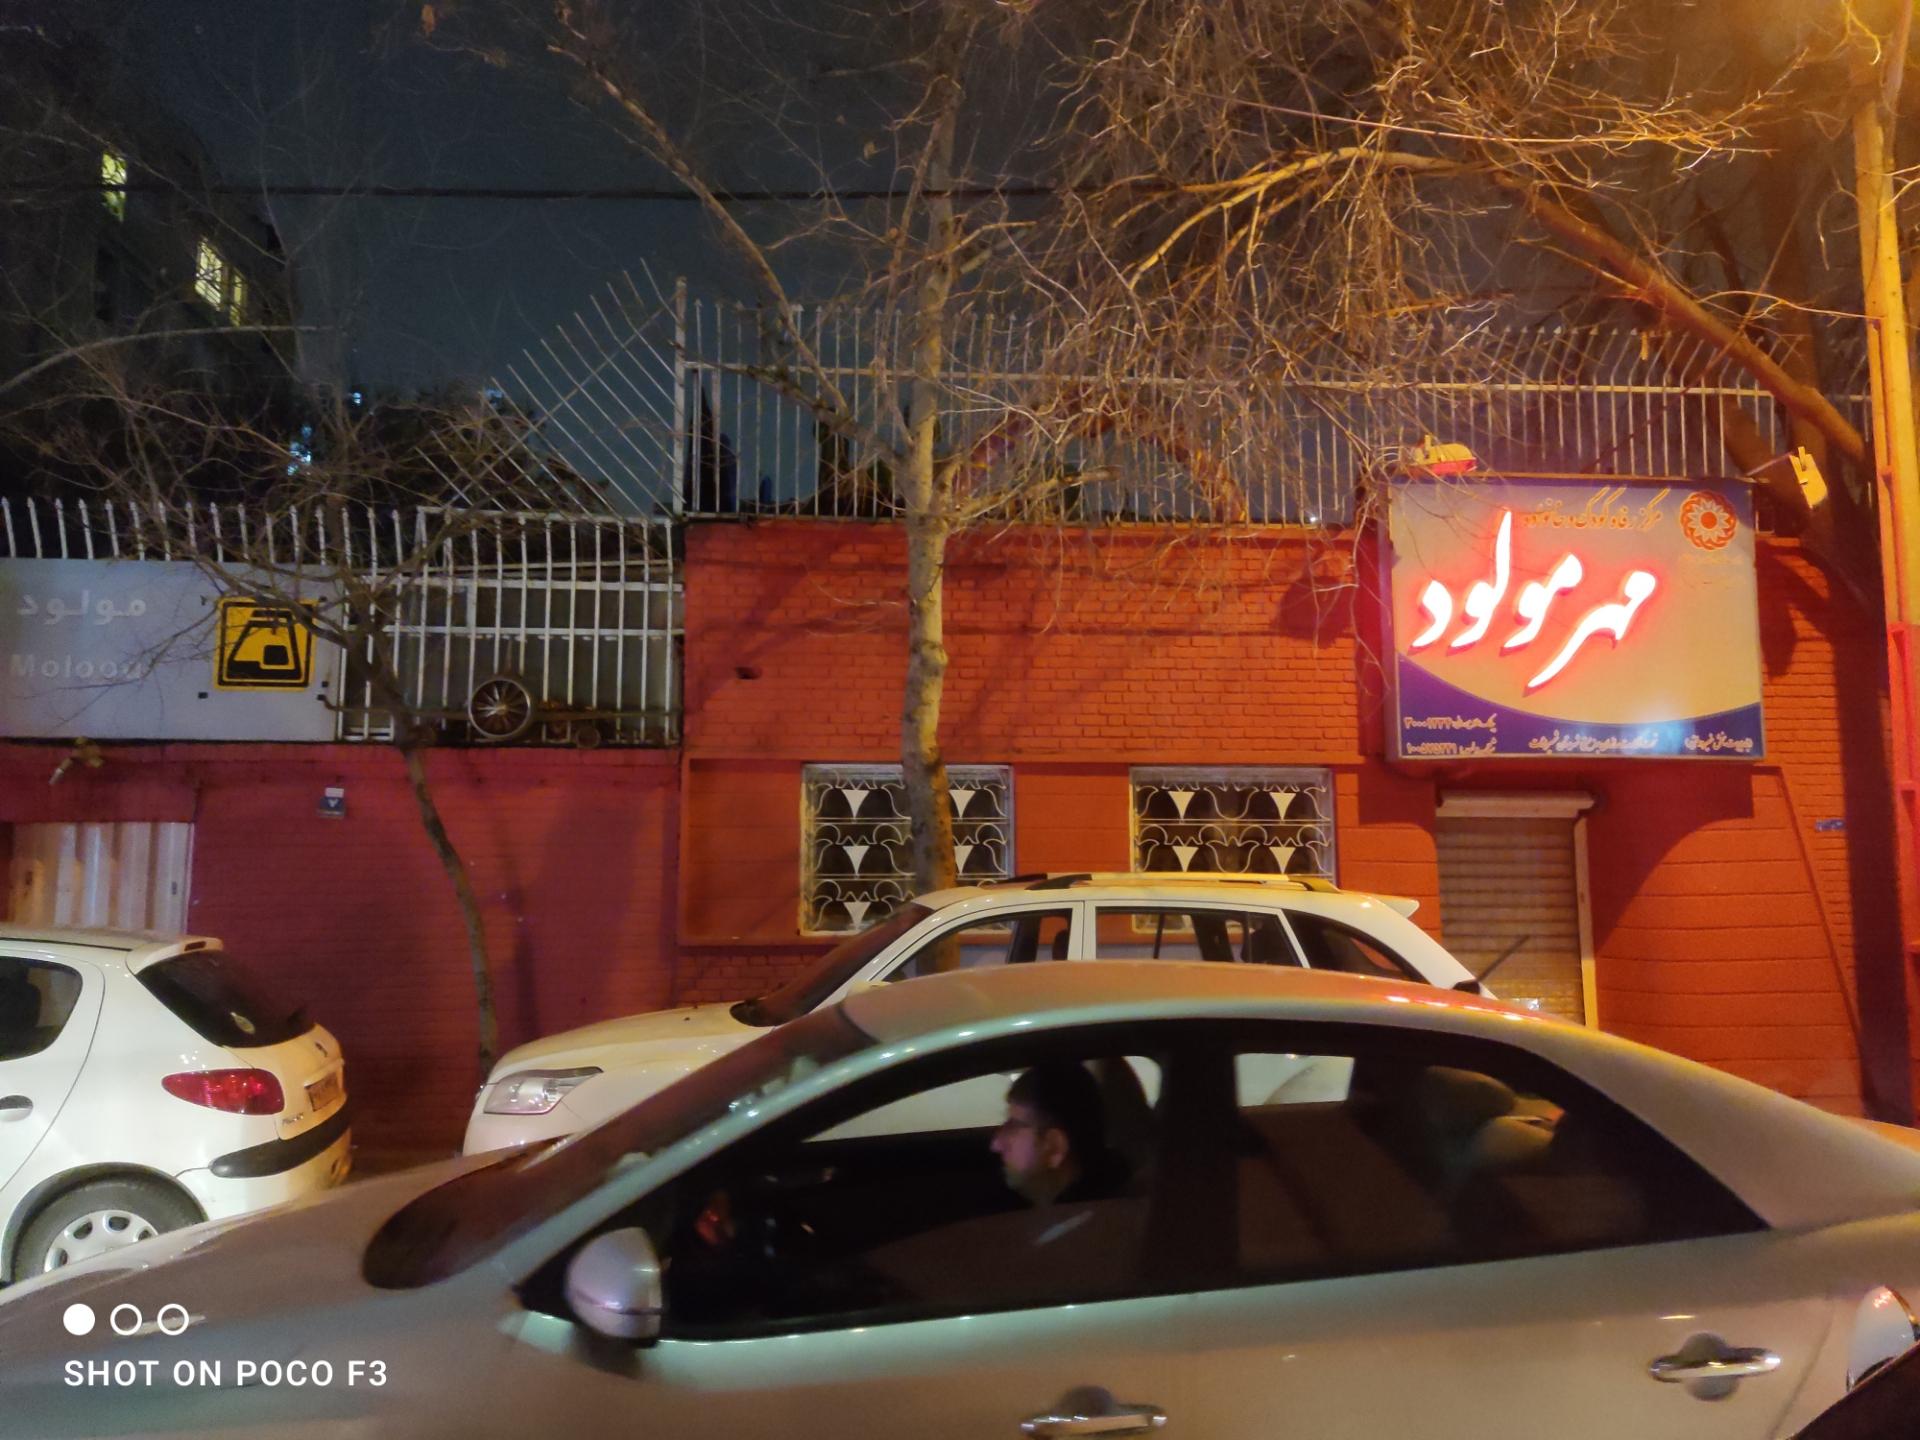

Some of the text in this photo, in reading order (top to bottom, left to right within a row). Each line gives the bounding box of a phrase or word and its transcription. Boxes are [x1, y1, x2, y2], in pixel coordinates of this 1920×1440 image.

[1574, 485, 1627, 529] کودک
[1639, 487, 1671, 531] مرکز
[16, 589, 147, 626] مولود
[1409, 508, 1657, 692] مهر مولود
